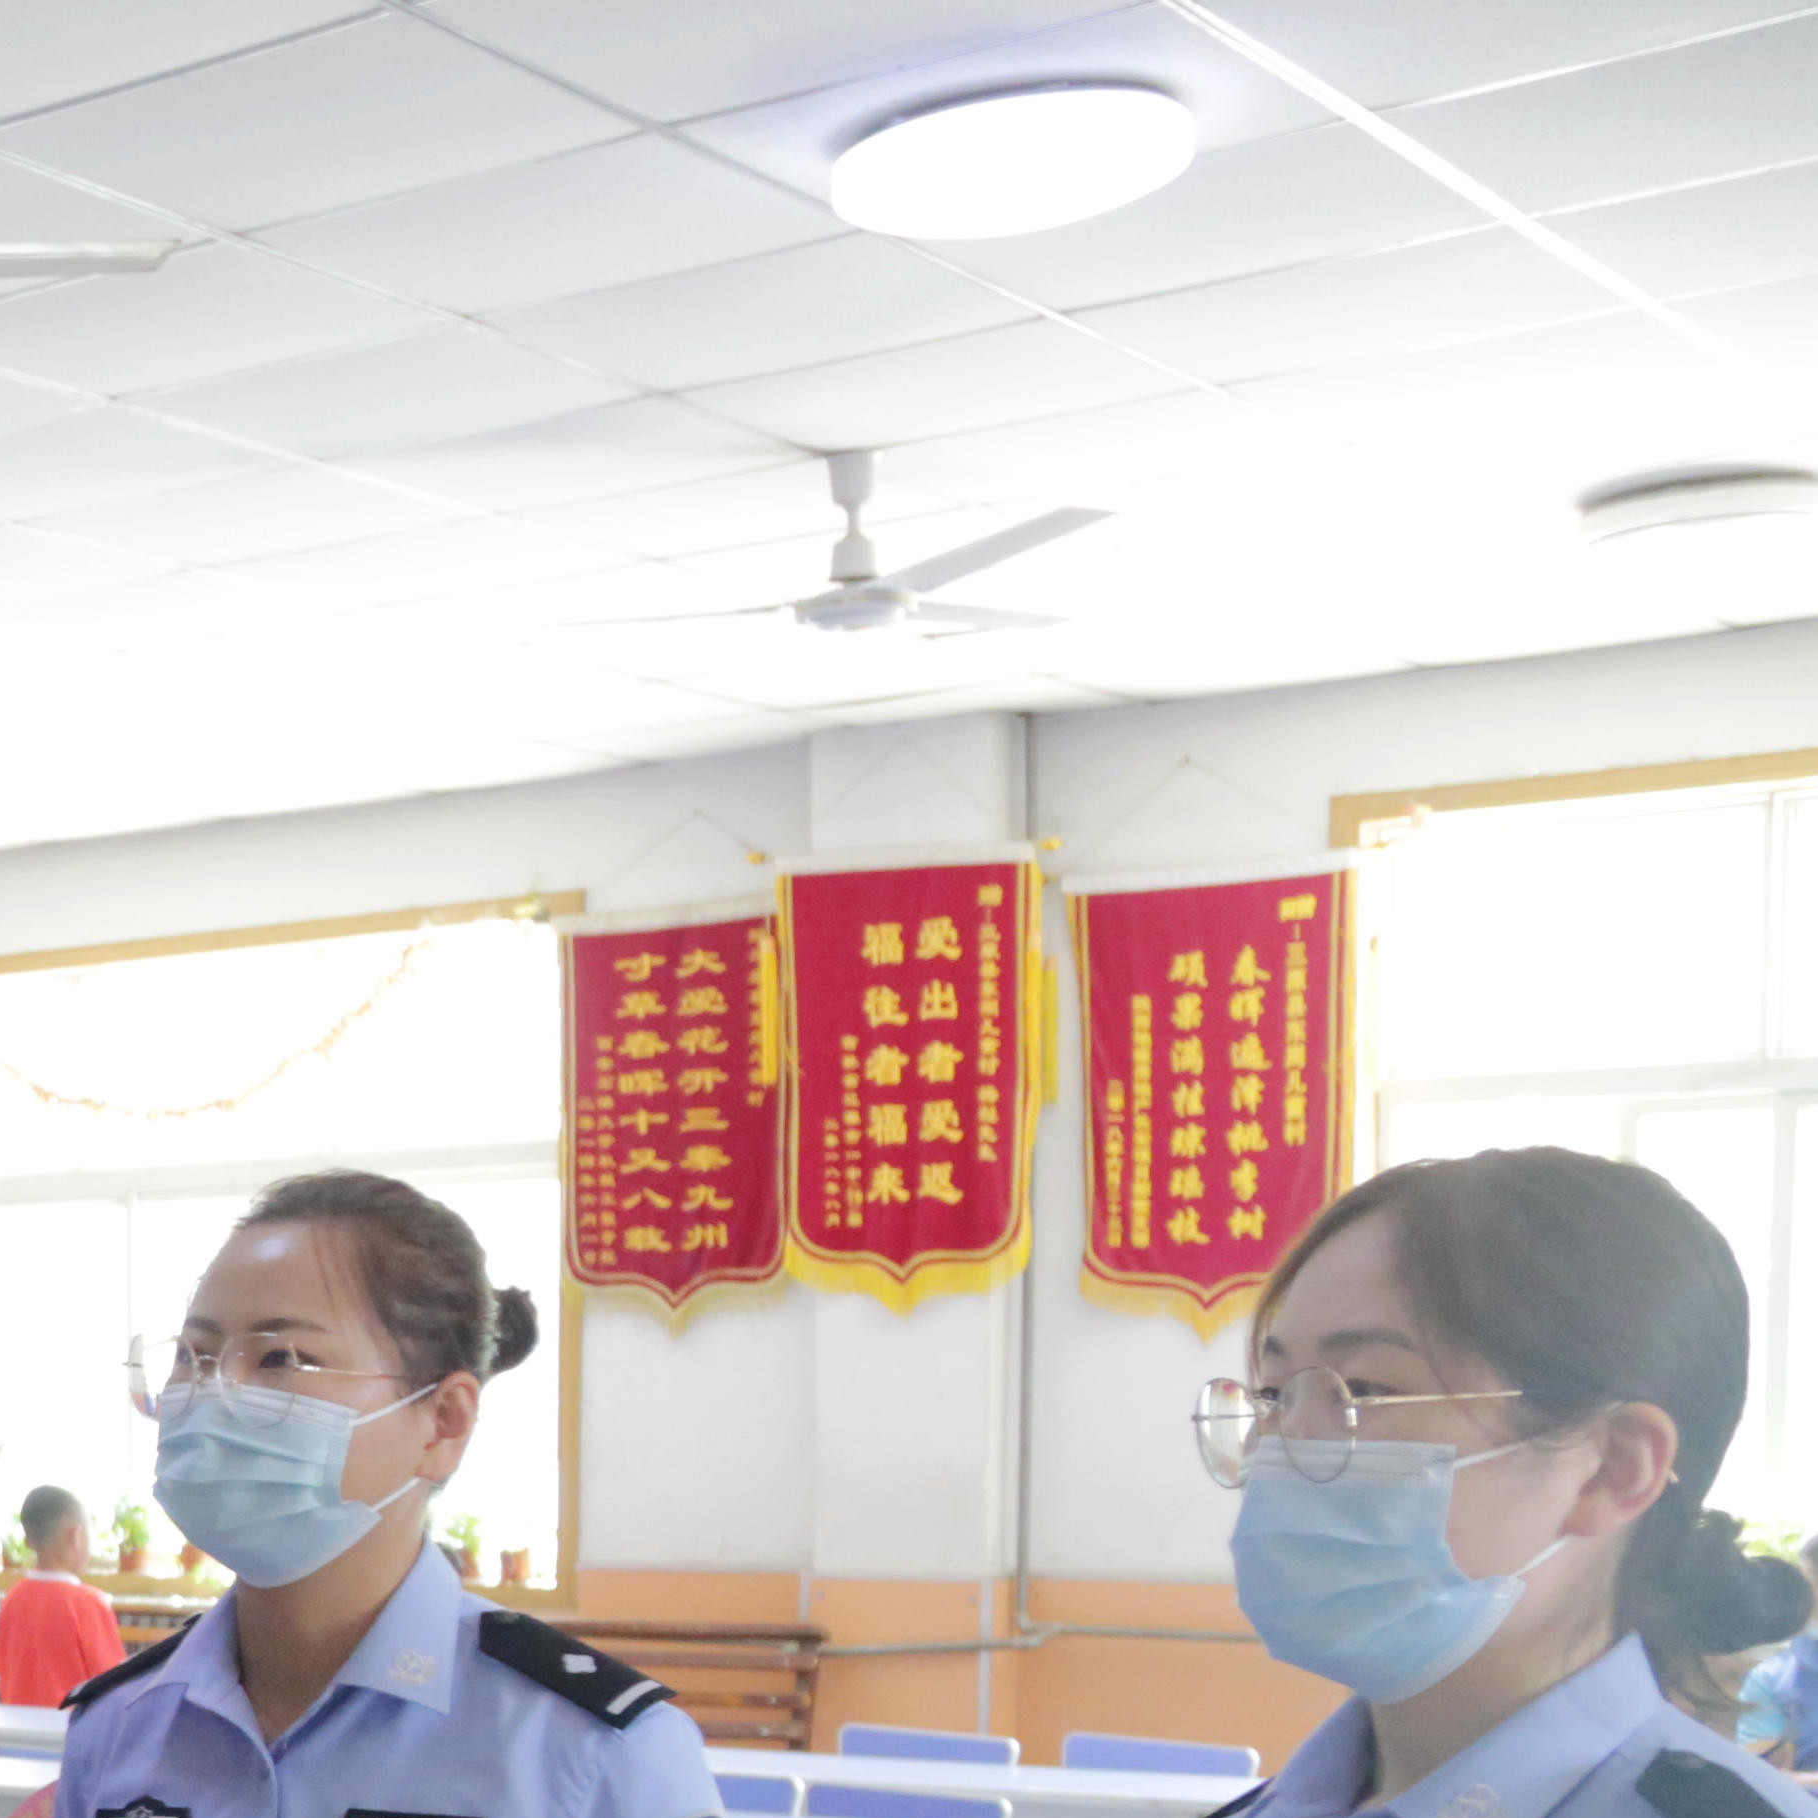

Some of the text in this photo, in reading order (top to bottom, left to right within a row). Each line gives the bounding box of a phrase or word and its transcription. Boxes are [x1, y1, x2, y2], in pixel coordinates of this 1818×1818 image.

[860, 921, 911, 1205] 福往者福来
